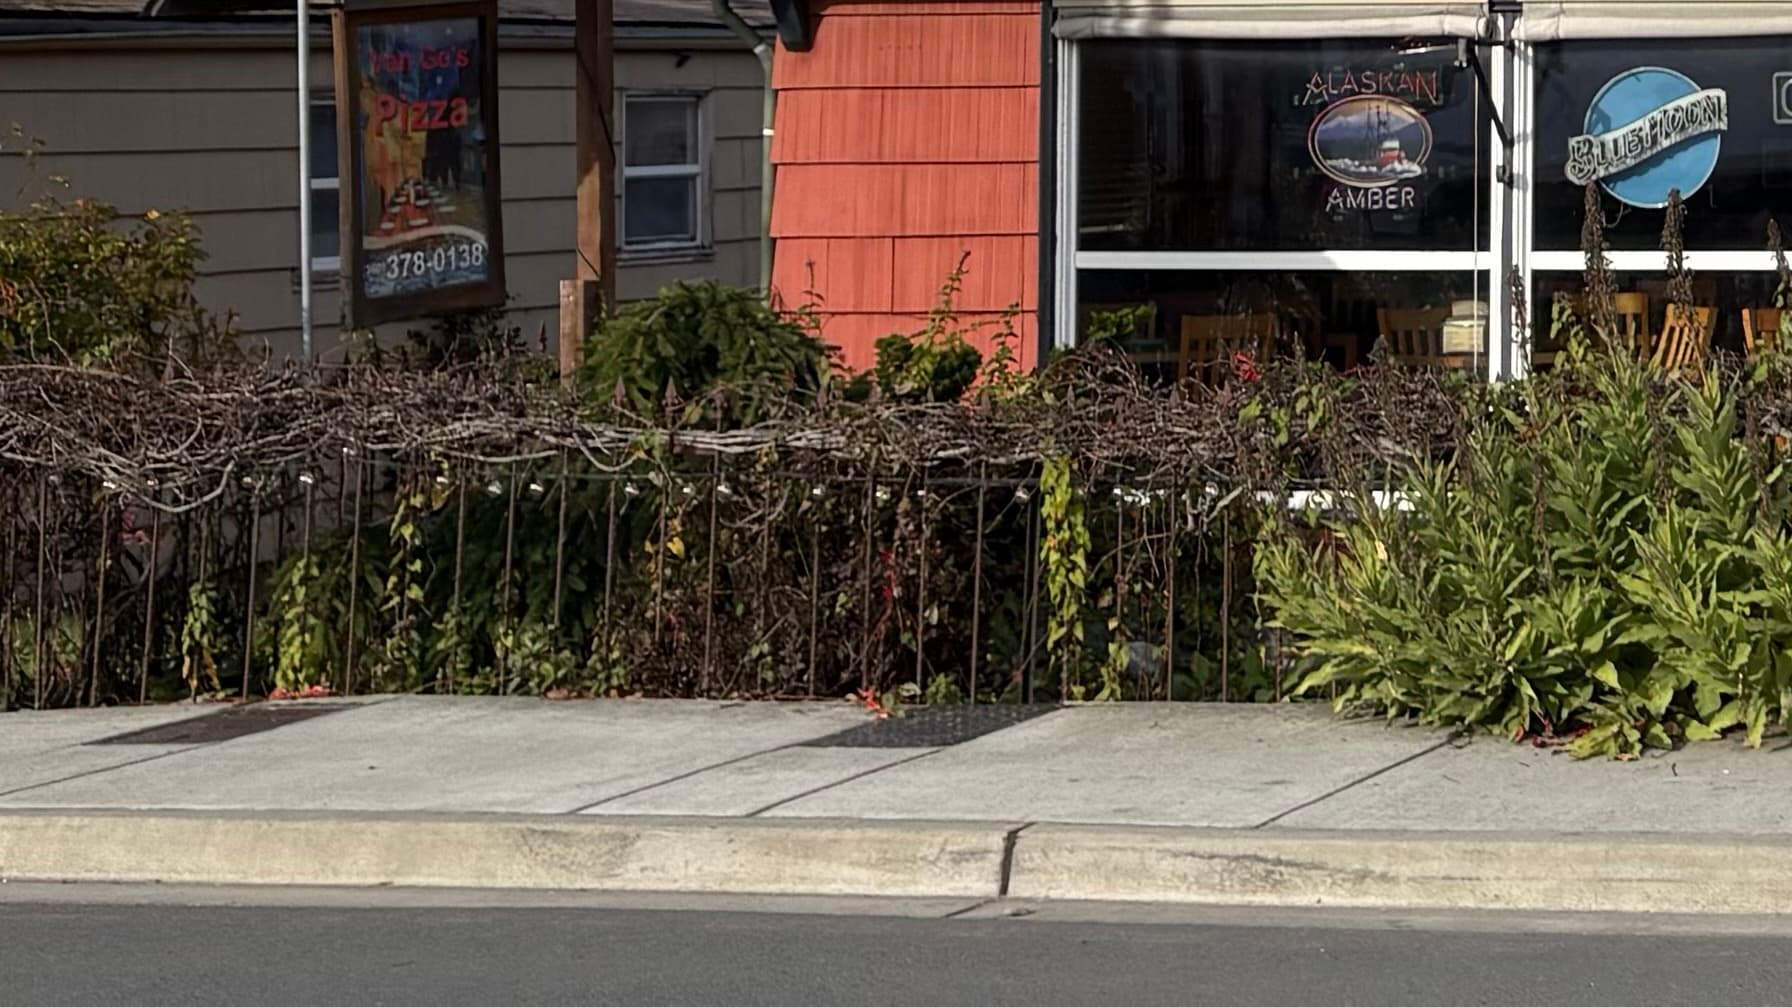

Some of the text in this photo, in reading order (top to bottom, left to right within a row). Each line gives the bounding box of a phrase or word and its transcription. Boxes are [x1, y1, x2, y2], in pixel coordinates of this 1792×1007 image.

[1303, 70, 1438, 106] ALASKAN
[372, 96, 469, 137] Pizza
[1325, 187, 1416, 212] AMBER
[386, 242, 484, 280] 378-0138
